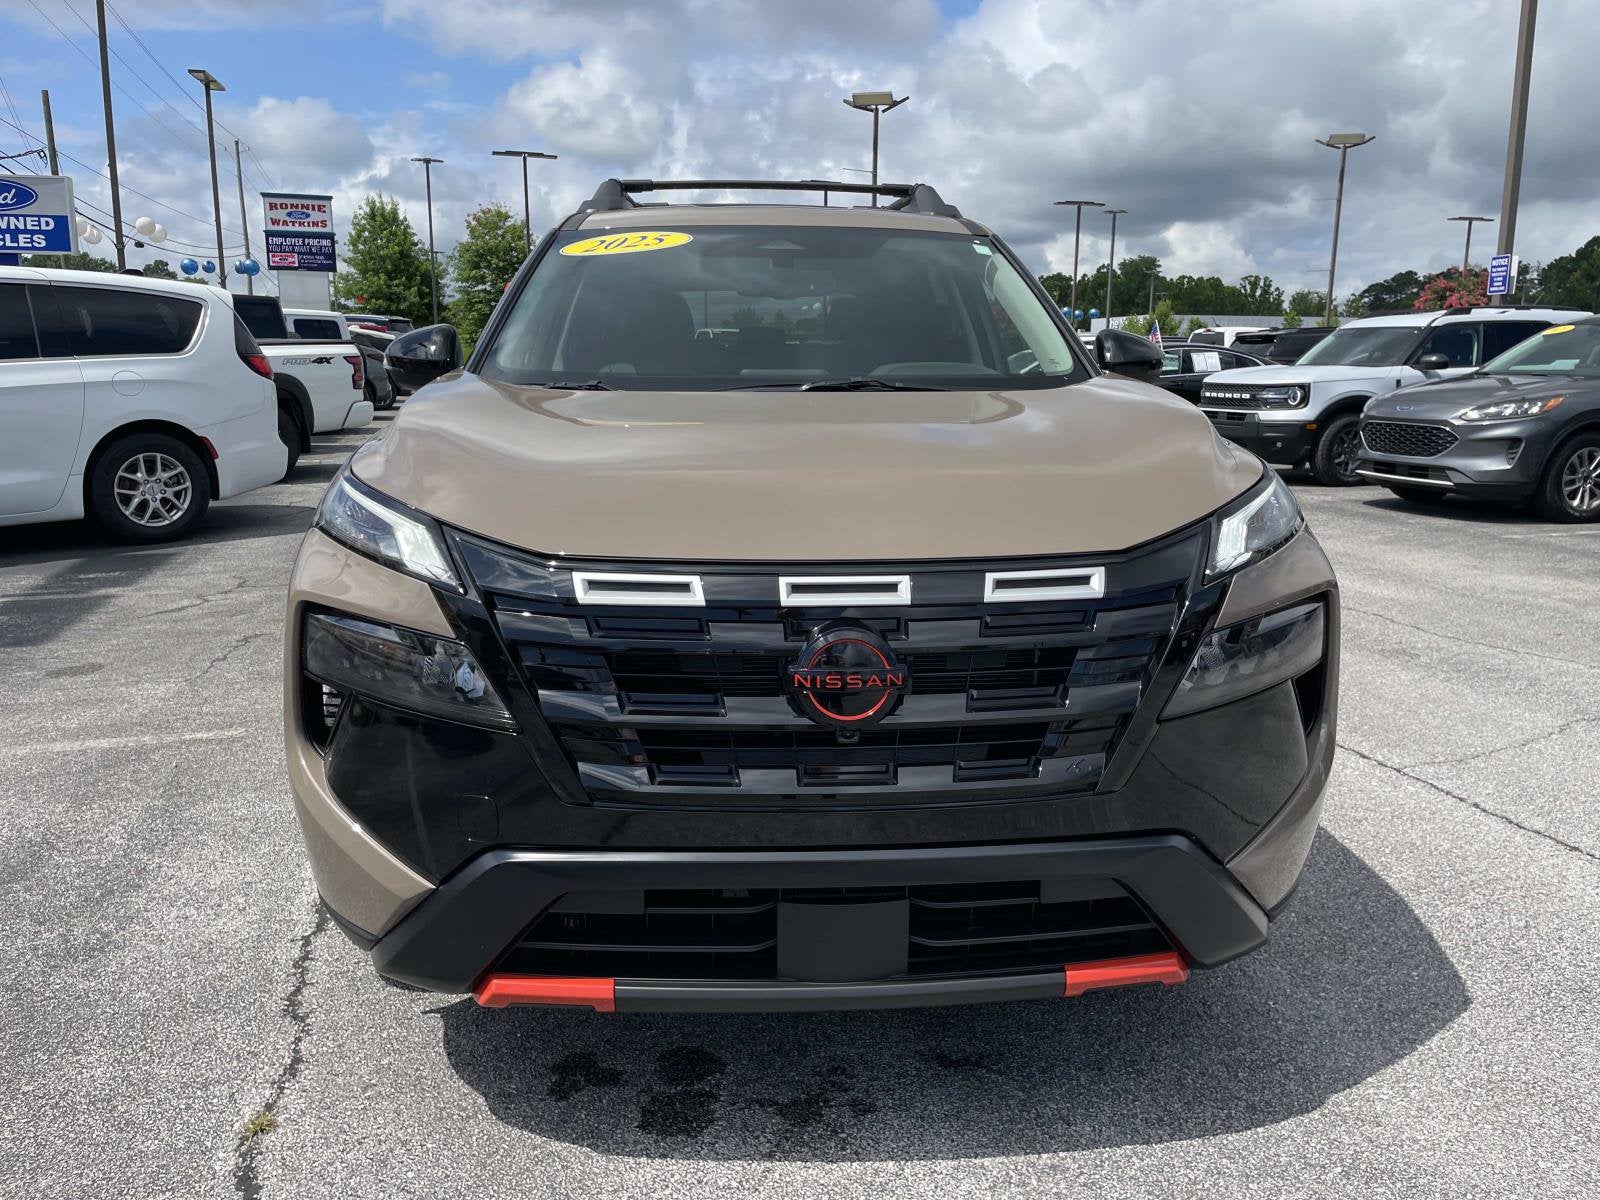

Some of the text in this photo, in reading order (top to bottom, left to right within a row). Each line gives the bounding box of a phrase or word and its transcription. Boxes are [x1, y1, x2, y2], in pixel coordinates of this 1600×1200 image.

[268, 202, 326, 213] RONNIE
[270, 217, 327, 228] WATKINS
[268, 237, 331, 246] EMPLOYEE PRICING
[581, 234, 671, 253] 2025
[293, 245, 310, 253] WHAT
[321, 246, 333, 254] PAY
[1204, 391, 1251, 399] BRONCO
[793, 672, 903, 688] NISSAN
